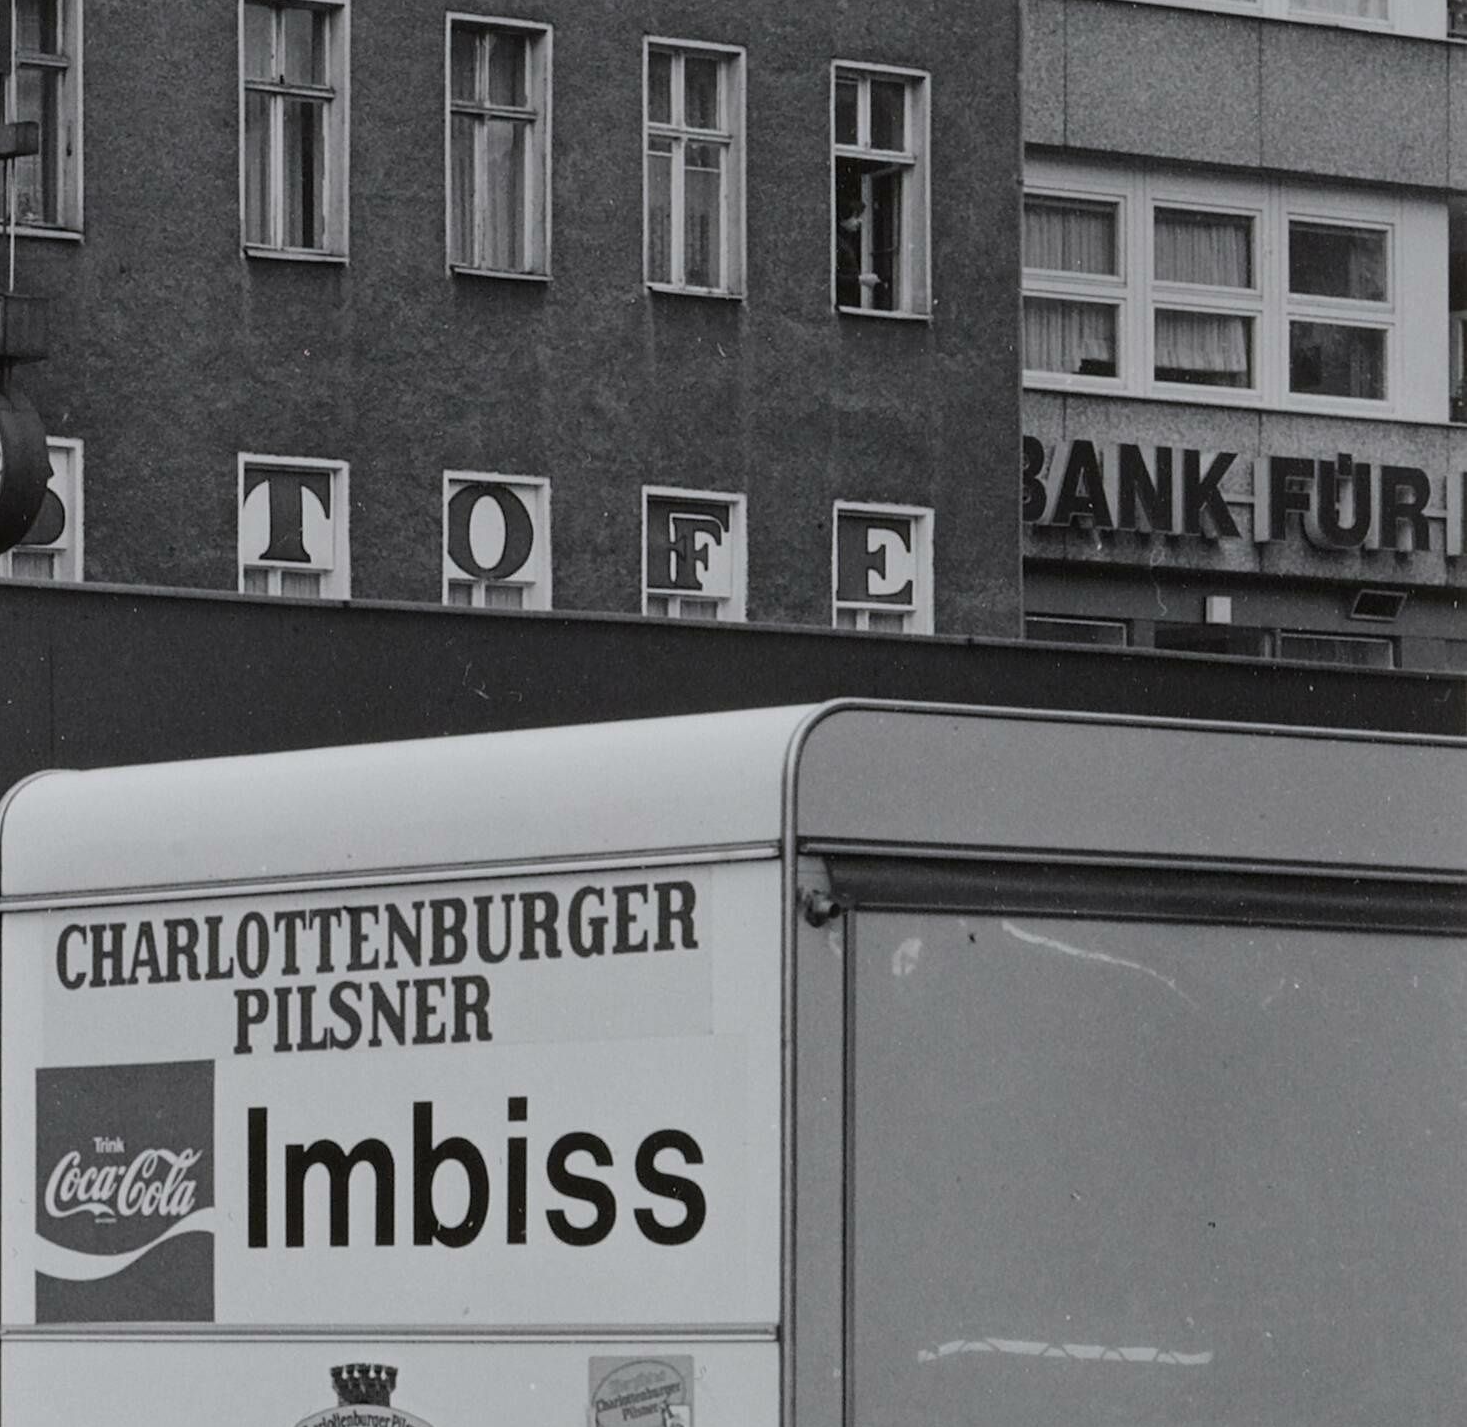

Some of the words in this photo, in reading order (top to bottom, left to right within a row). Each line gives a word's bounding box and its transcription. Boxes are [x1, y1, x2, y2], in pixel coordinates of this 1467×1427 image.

[1264, 453, 1431, 552] FÜR
[55, 879, 700, 991] CHARLOTTENBURGER
[233, 975, 493, 1056] PILSNER
[44, 1147, 204, 1219] Coca-Cola
[94, 1136, 126, 1154] Trink
[247, 1096, 708, 1249] Imbiss
